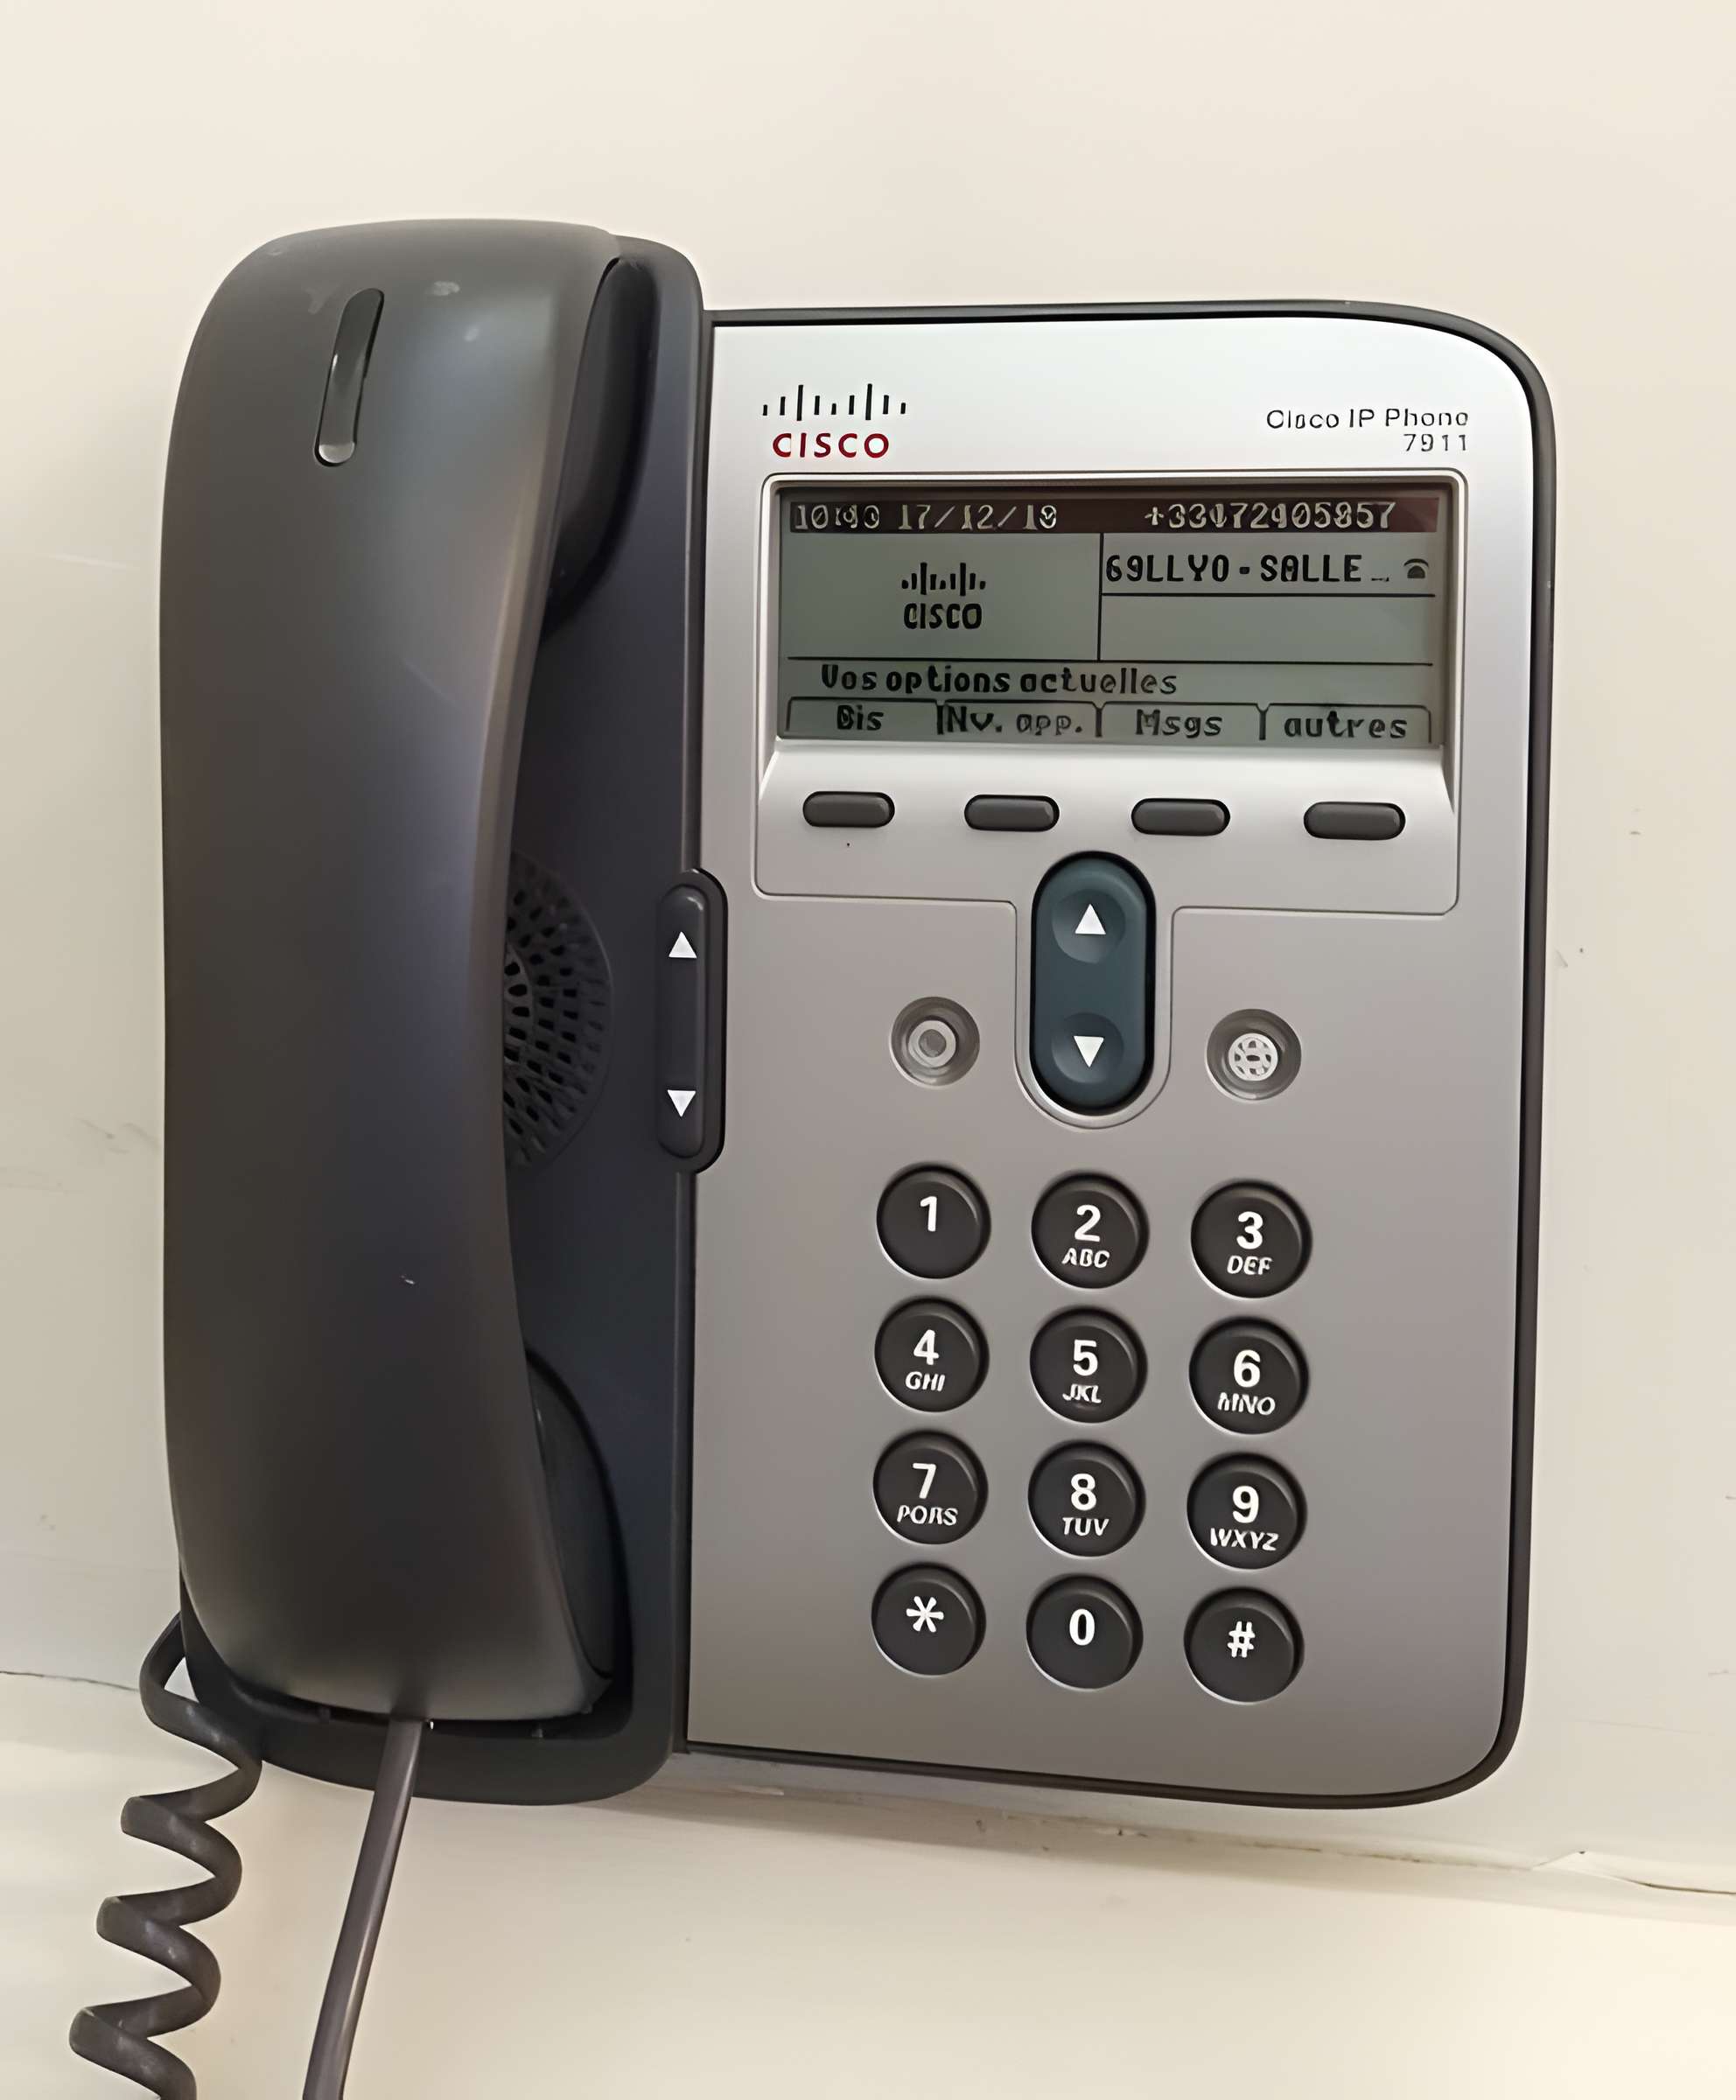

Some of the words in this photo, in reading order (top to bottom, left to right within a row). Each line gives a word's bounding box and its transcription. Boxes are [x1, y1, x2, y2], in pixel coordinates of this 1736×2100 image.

[1266, 410, 1340, 430] Cisco
[1349, 409, 1375, 428] IP
[1385, 408, 1468, 427] Phone
[772, 432, 890, 458] CISCO
[1404, 433, 1466, 452] 7911
[903, 602, 983, 630] CISCO
[821, 663, 878, 691] Vos
[886, 664, 1011, 695] options
[1019, 667, 1177, 695] actuelles
[836, 704, 885, 732] Bis
[1016, 713, 1082, 737] app.
[1135, 708, 1223, 739] Msgs
[1284, 710, 1408, 739] autres
[920, 1195, 938, 1232] 1
[1074, 1204, 1101, 1242] 2
[1236, 1211, 1264, 1250] 3
[1061, 1247, 1110, 1269] ABC
[1227, 1255, 1272, 1276] DEF
[913, 1329, 940, 1366] 4
[1073, 1339, 1098, 1376] 5
[905, 1370, 946, 1392] GHI
[1233, 1349, 1261, 1388] 6
[1061, 1383, 1102, 1404] JKL
[1217, 1391, 1276, 1416] MNO
[913, 1462, 937, 1500] 7
[1070, 1473, 1097, 1511] 8
[1232, 1485, 1259, 1523] 9
[1062, 1516, 1110, 1536] TUV
[1210, 1527, 1279, 1551] WXYZ
[1069, 1608, 1096, 1646] 0
